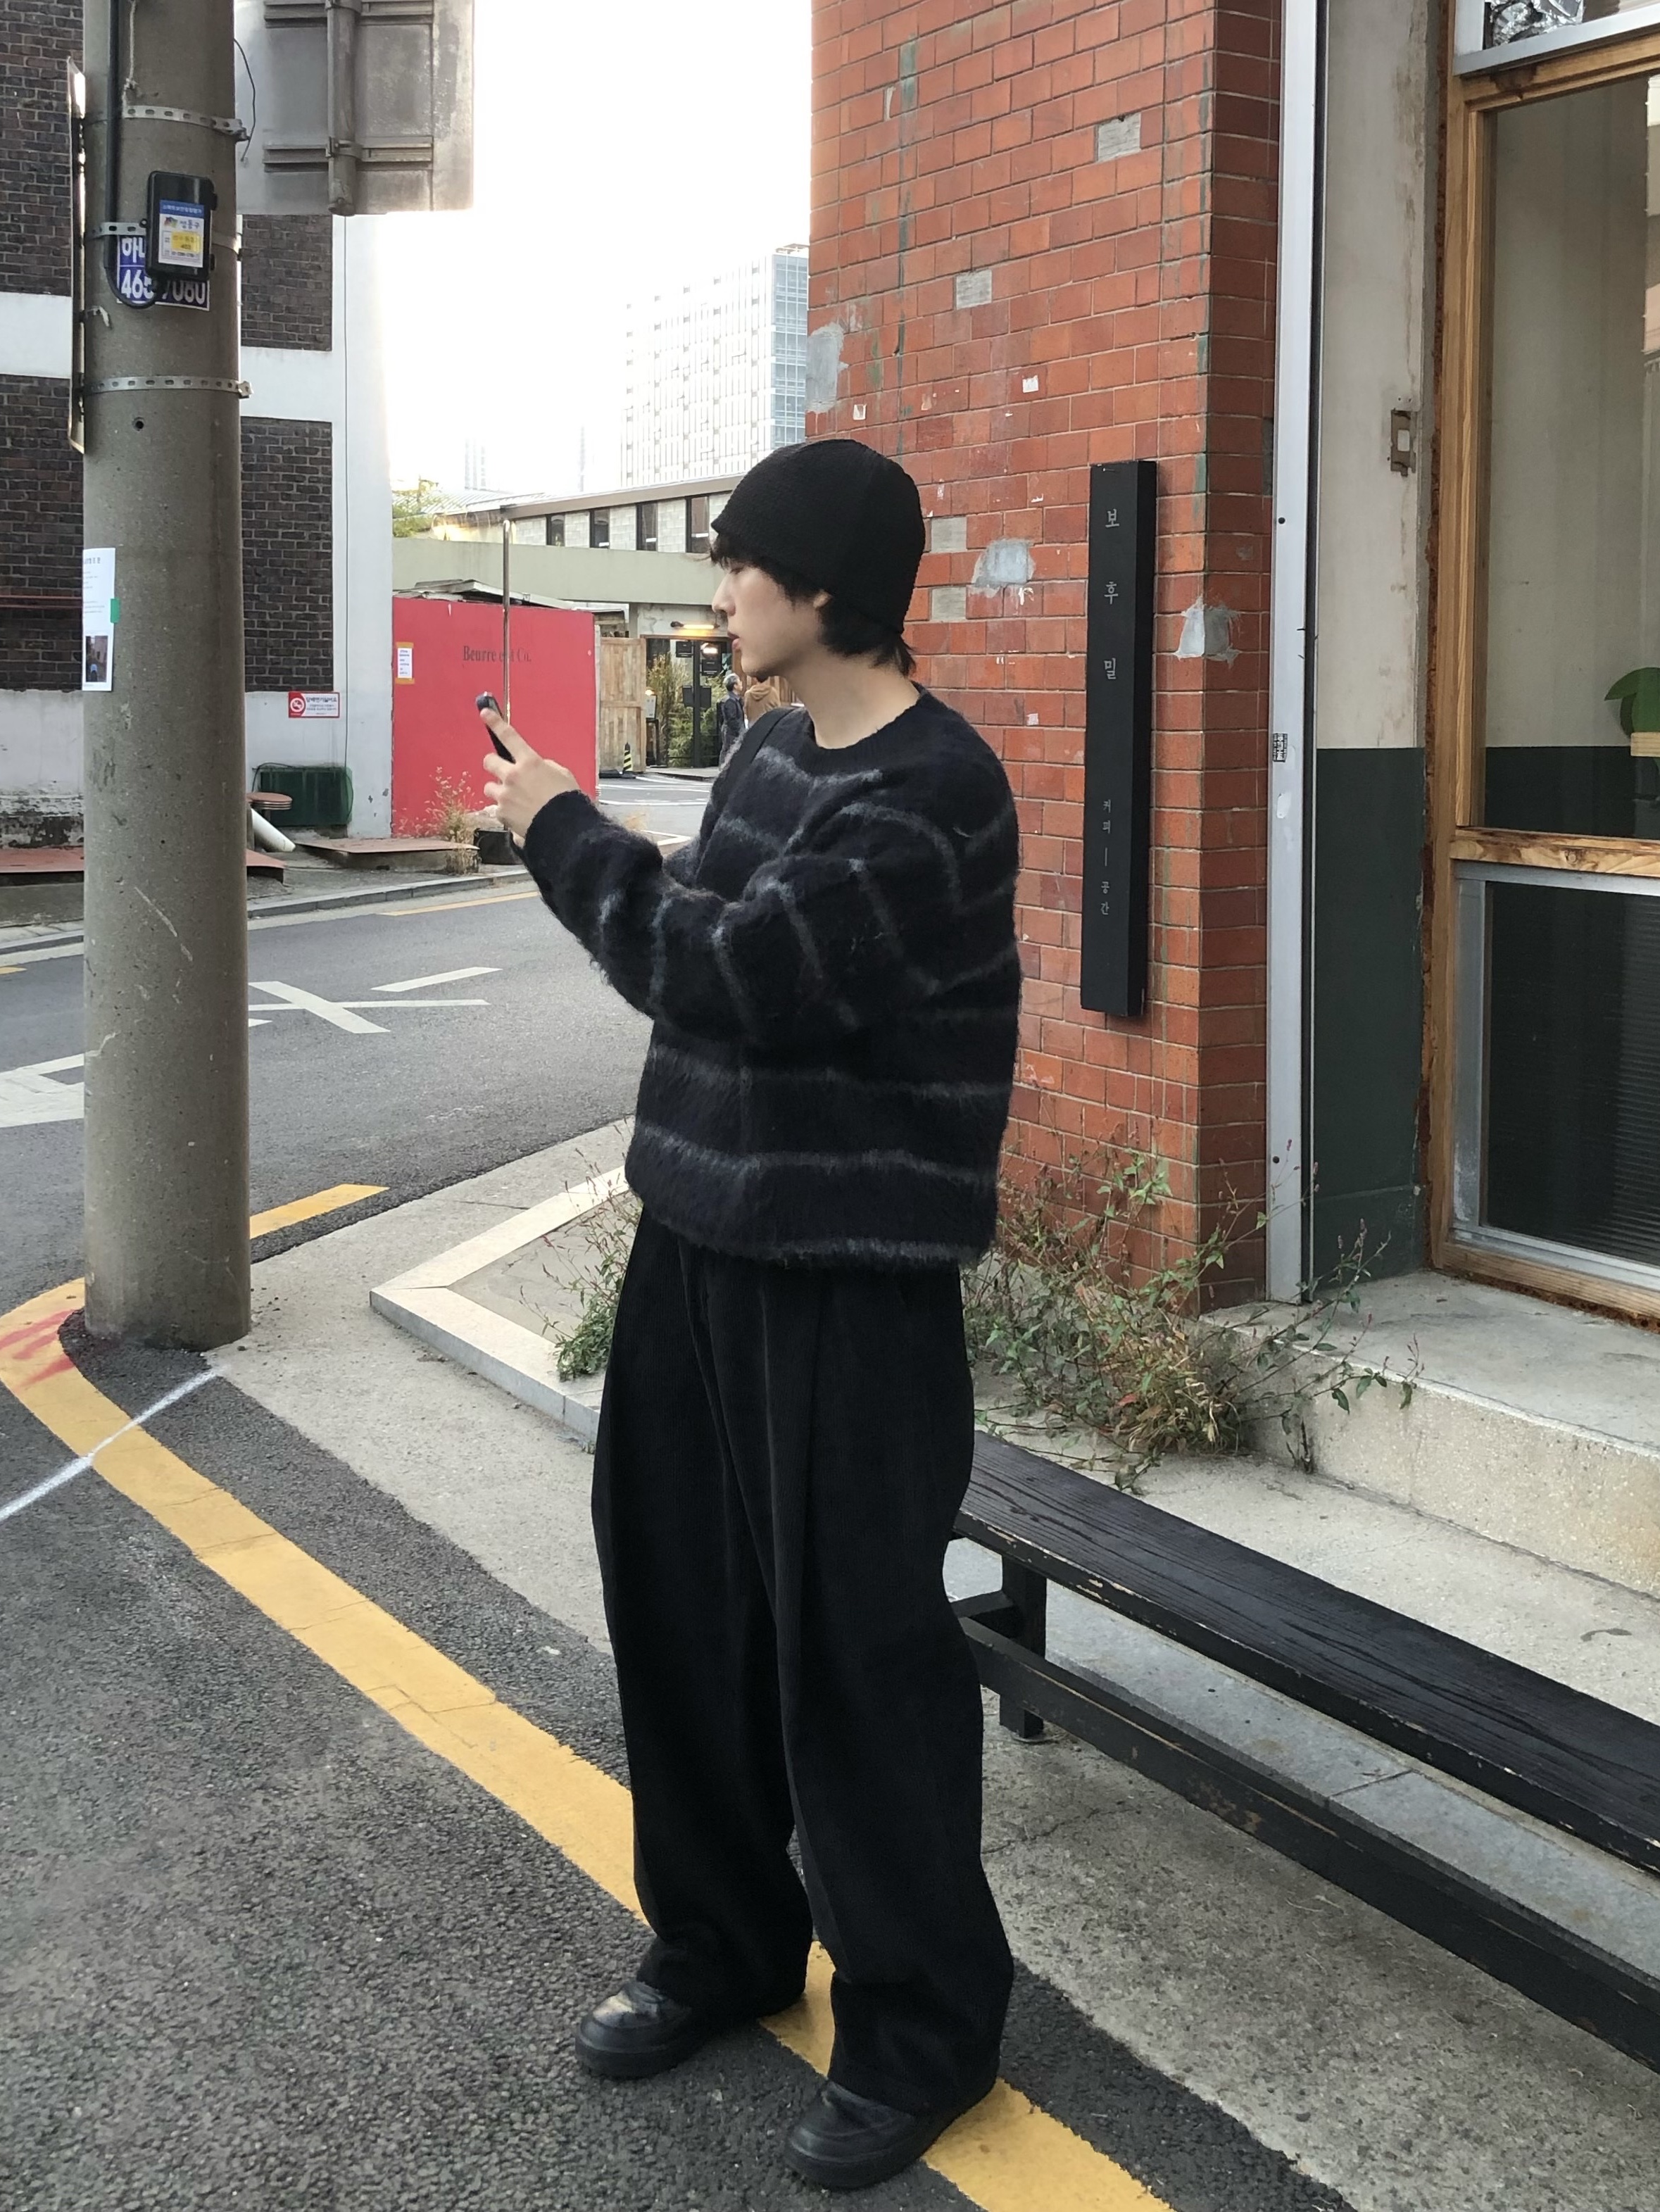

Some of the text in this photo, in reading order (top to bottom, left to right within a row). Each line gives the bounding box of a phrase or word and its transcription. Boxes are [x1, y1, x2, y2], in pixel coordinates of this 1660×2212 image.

[1103, 508, 1120, 680] 보후밀
[463, 645, 497, 662] Beurre
[1100, 799, 1111, 915] 커피 공간
